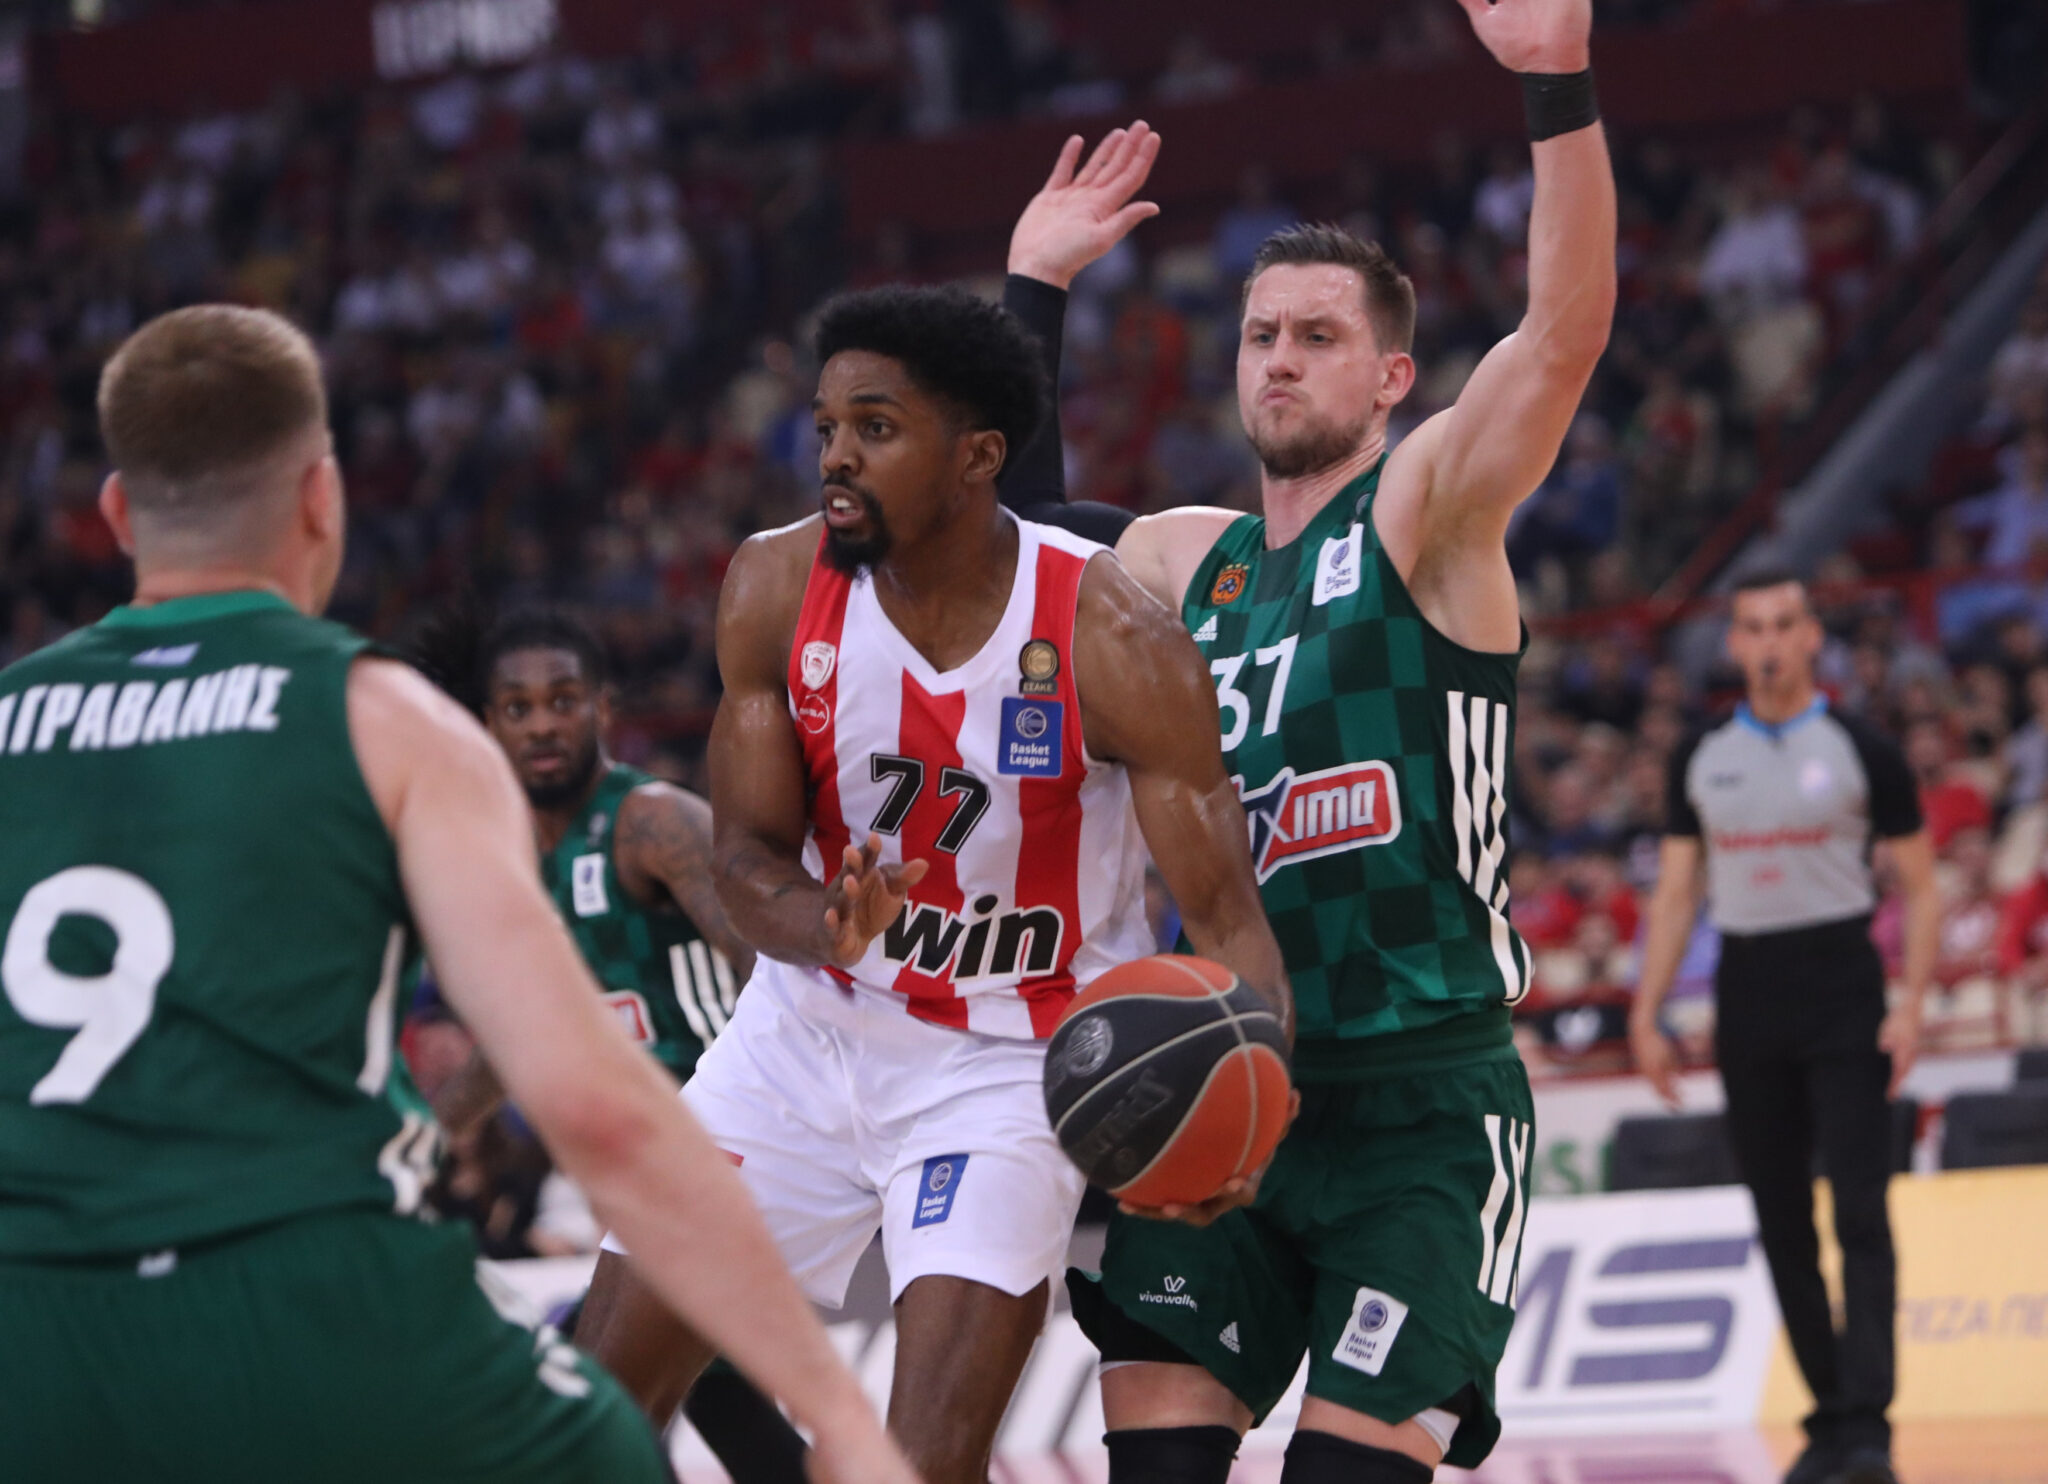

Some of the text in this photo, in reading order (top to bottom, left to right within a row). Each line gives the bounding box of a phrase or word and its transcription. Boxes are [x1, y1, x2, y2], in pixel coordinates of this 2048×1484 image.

[1209, 633, 1300, 752] 37
[1009, 754, 1050, 768] League
[1010, 742, 1050, 756] Basket
[870, 753, 992, 855] 77
[1, 865, 175, 1105] 9
